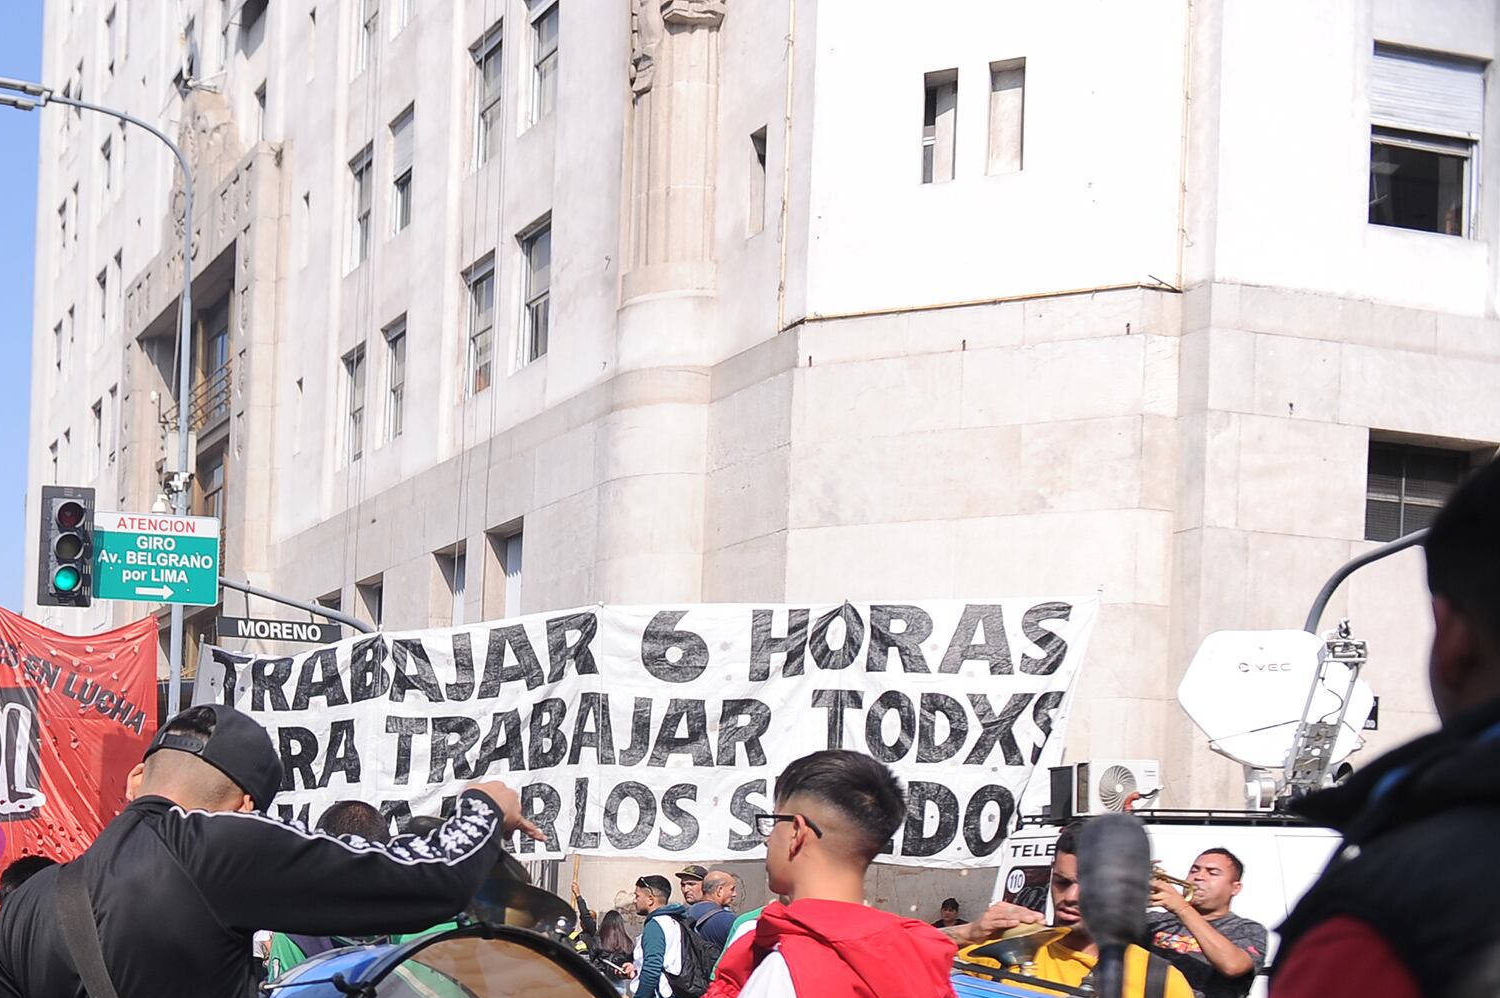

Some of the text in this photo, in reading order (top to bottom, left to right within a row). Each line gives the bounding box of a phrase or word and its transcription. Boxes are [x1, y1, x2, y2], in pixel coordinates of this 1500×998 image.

[116, 516, 196, 533] ATENCION
[136, 535, 176, 551] GIRO
[98, 550, 213, 569] Av. BELGRANO
[122, 570, 189, 583] por LIMA
[237, 619, 321, 642] MORENO
[212, 601, 1073, 712] TRABAJAR 6 HORAS
[62, 669, 147, 735] LUCHA
[385, 692, 772, 786] TRABAJAR
[1009, 873, 1023, 889] 110
